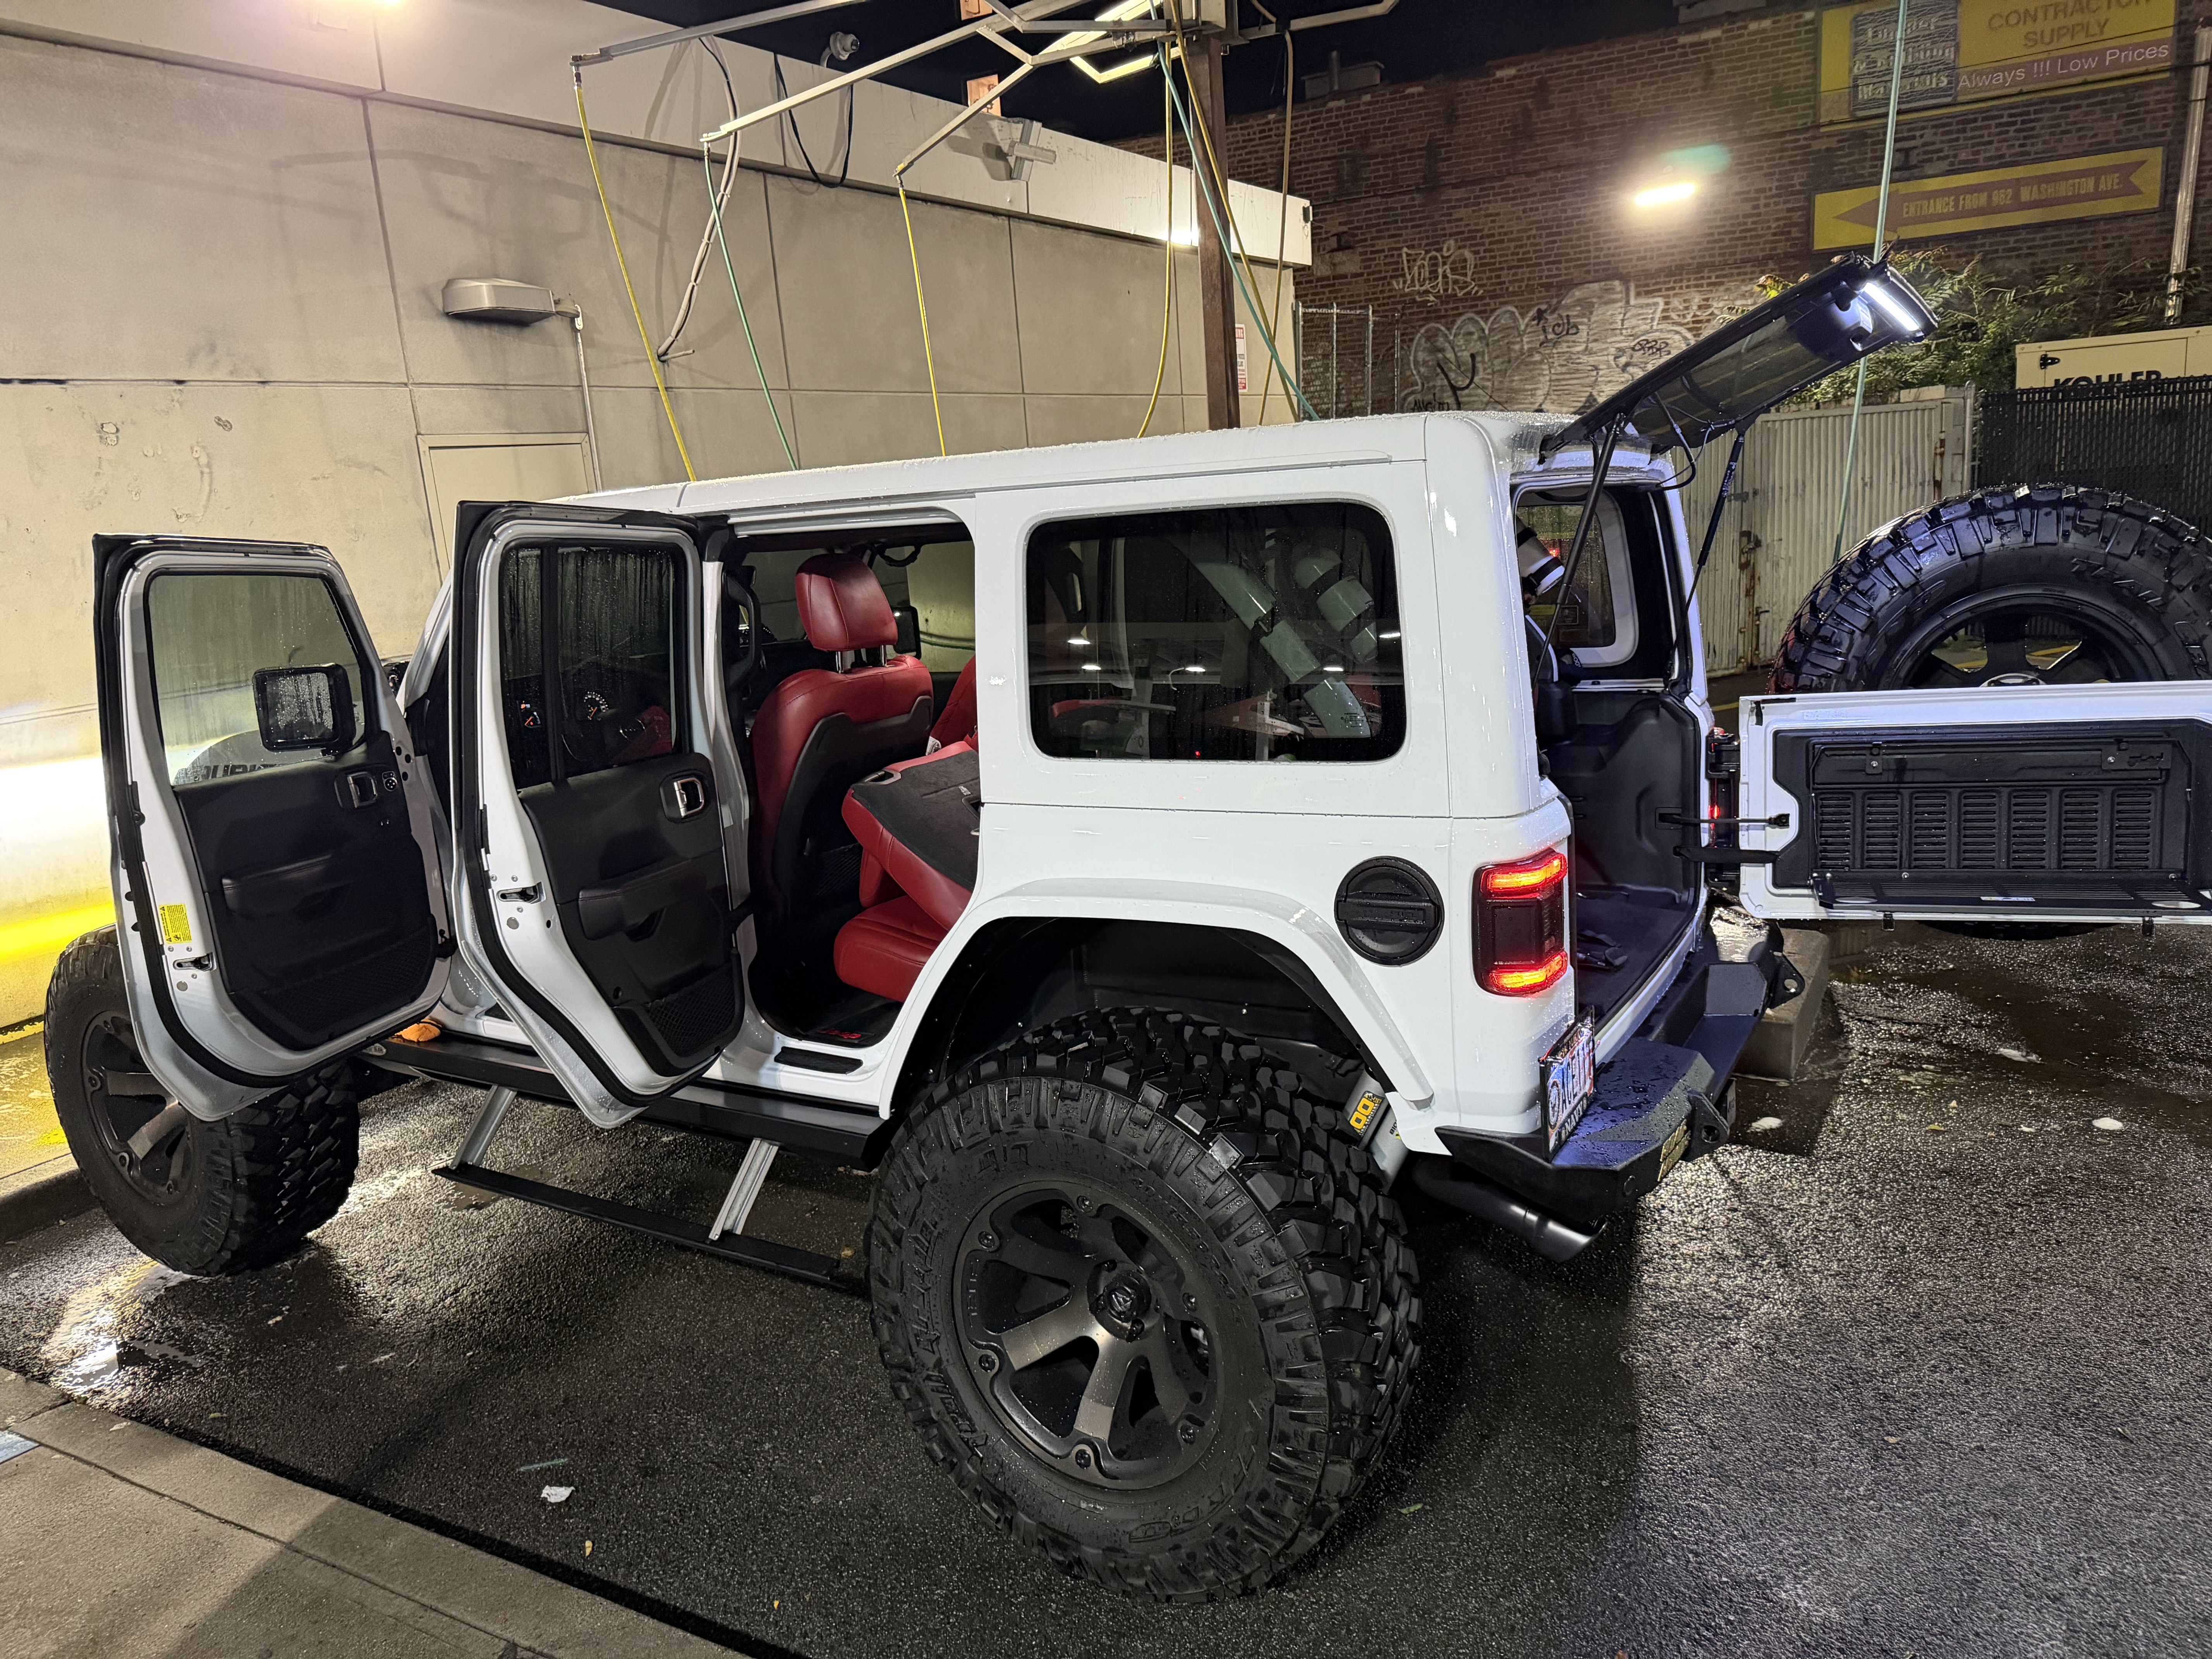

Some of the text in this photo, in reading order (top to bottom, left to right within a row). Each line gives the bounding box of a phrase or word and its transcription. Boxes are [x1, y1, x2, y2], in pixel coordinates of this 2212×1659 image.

[2023, 18, 2110, 47] SUPPLY
[1957, 65, 2026, 91] Always
[2057, 55, 2099, 74] Low
[2105, 43, 2169, 67] Prices
[1903, 196, 1955, 218] ENTRANCE
[1958, 192, 1988, 211] FROM
[2019, 177, 2095, 202] WASHINGTON
[1565, 1101, 1583, 1136] NAVY
